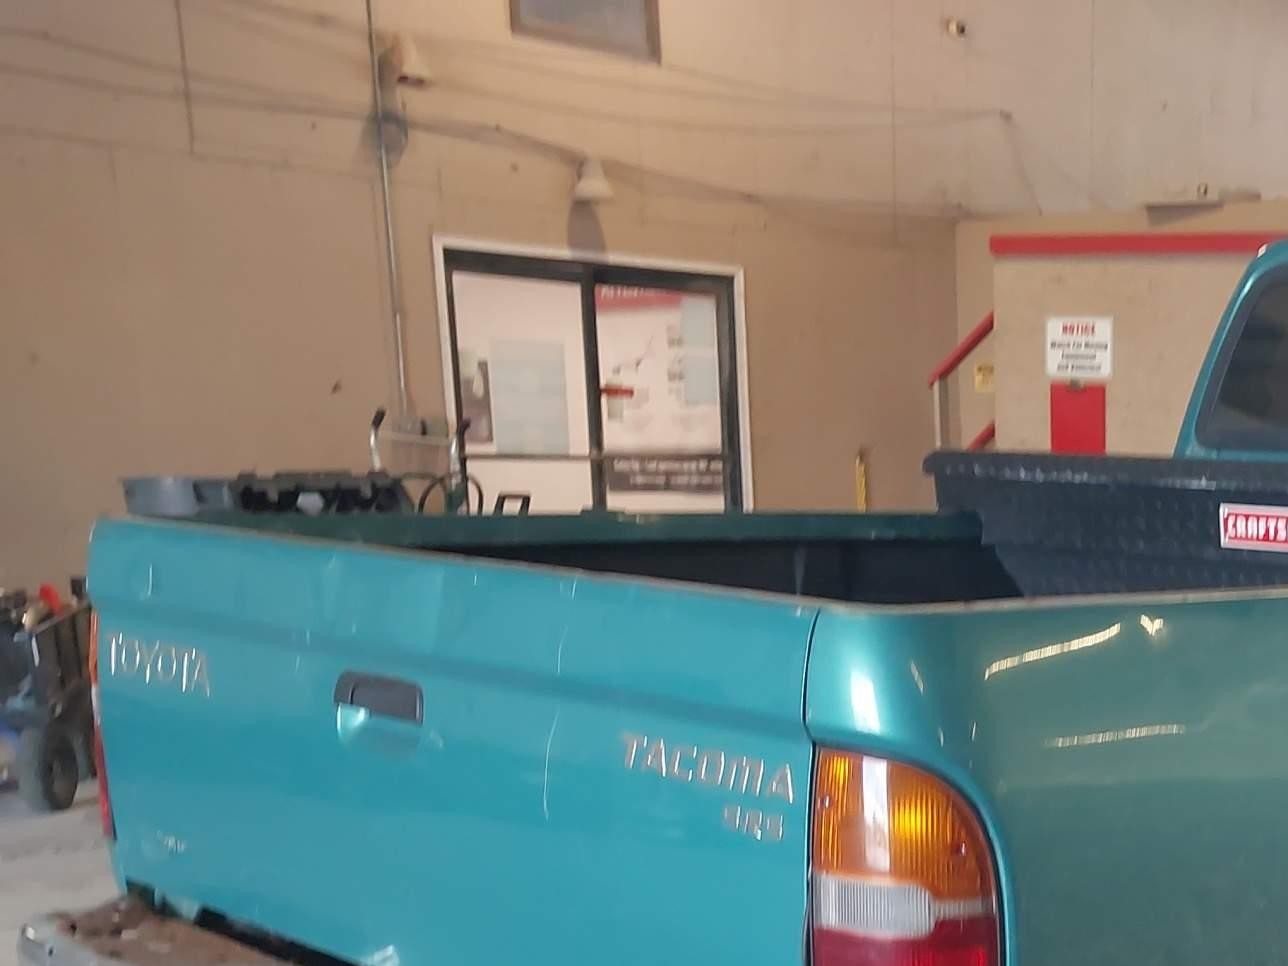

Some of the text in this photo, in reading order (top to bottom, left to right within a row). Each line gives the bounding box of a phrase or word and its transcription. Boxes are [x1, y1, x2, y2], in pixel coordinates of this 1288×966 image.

[1062, 323, 1095, 336] NOTICE
[107, 631, 211, 698] TOYOTA
[620, 731, 794, 804] TACOMA
